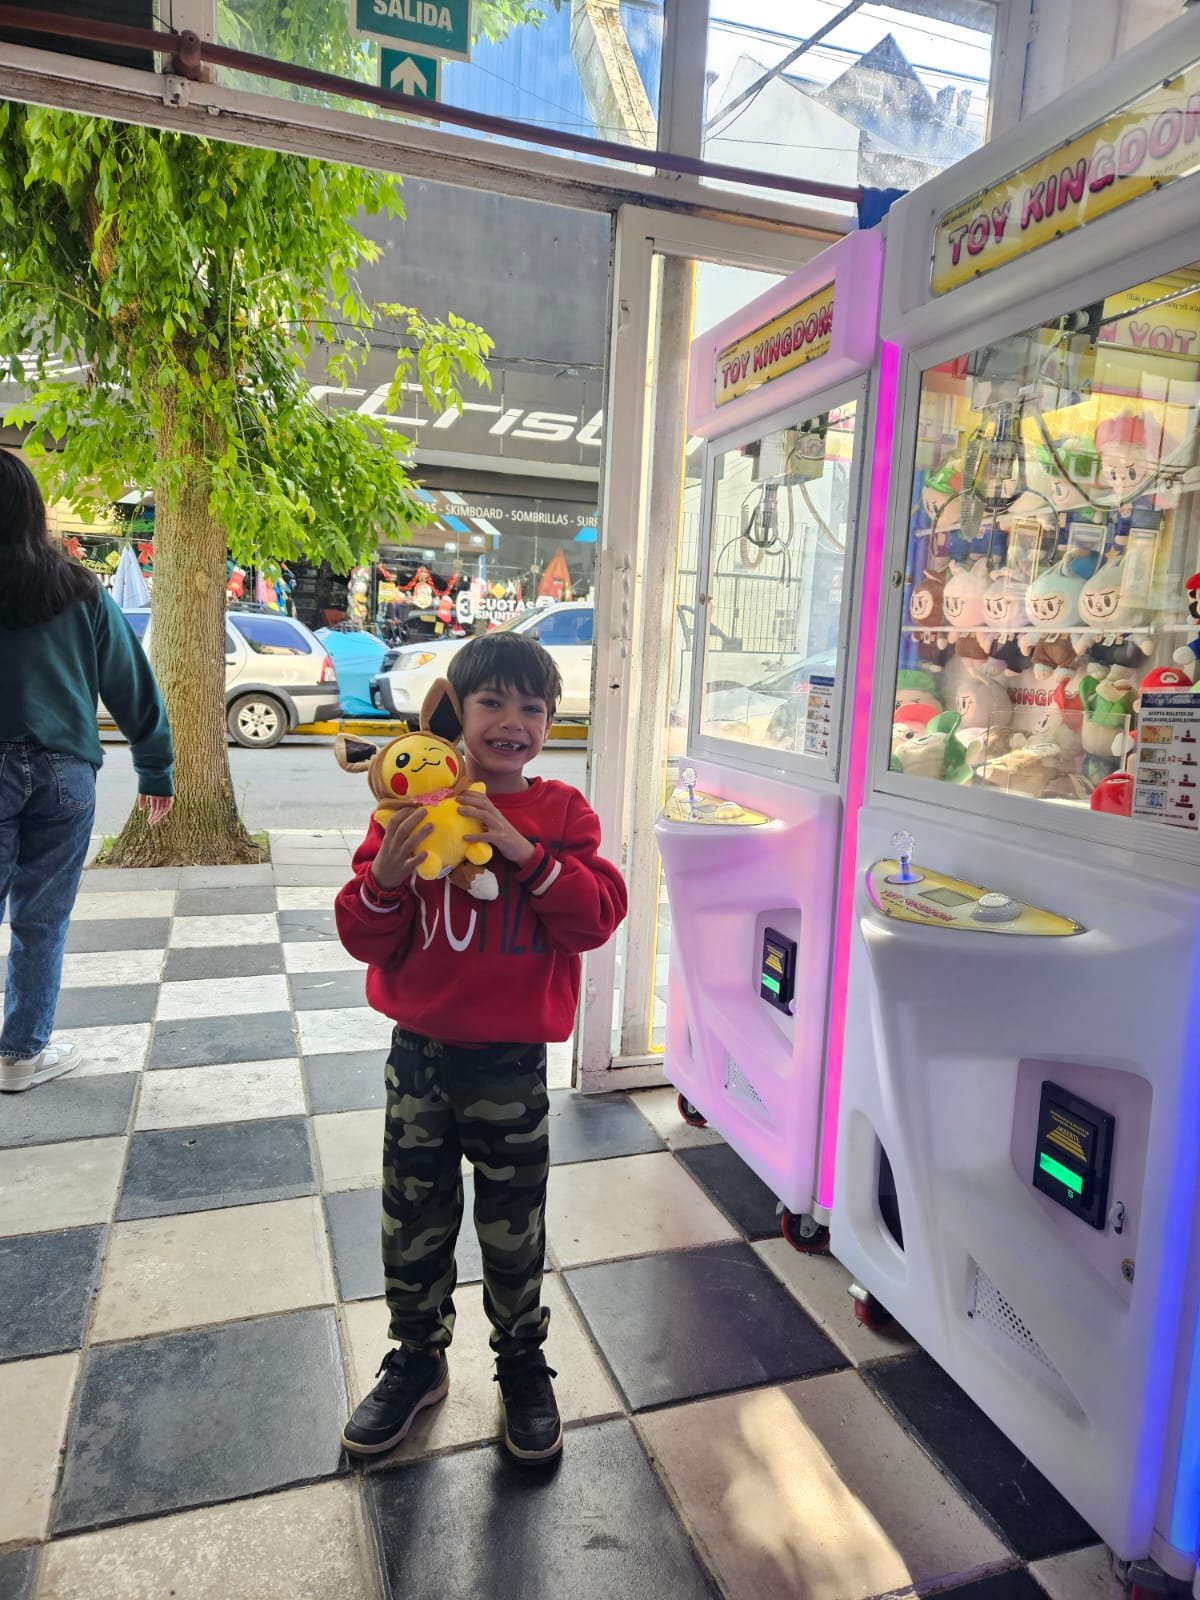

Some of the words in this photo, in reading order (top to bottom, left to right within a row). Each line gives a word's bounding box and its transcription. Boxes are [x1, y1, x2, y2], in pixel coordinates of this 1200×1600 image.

[373, 0, 453, 32] SALIDA
[949, 199, 1011, 265] TOY
[722, 350, 750, 388] TOY
[445, 503, 503, 520] SKIMBOARD
[511, 510, 569, 526] SOMBRILLAS
[478, 598, 534, 612] CUOTAS
